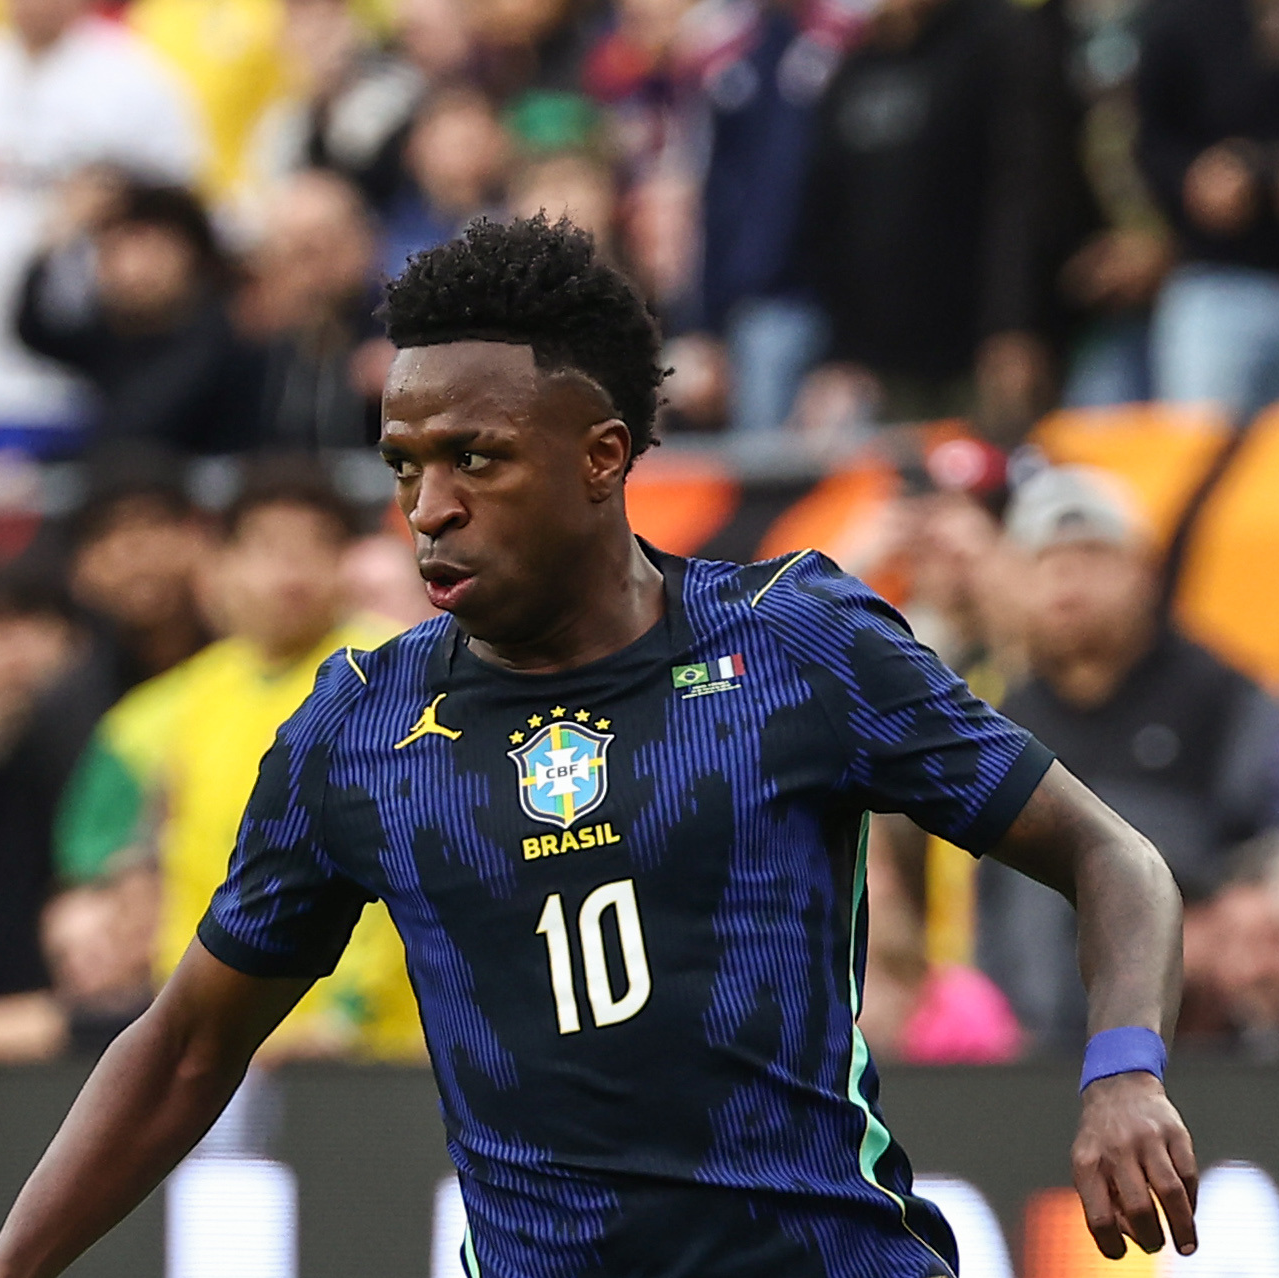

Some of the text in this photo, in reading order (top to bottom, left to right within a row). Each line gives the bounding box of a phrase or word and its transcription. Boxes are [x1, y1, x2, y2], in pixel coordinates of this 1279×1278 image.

[546, 762, 579, 779] CBF
[522, 822, 621, 860] BRASIL
[536, 878, 652, 1034] 10
